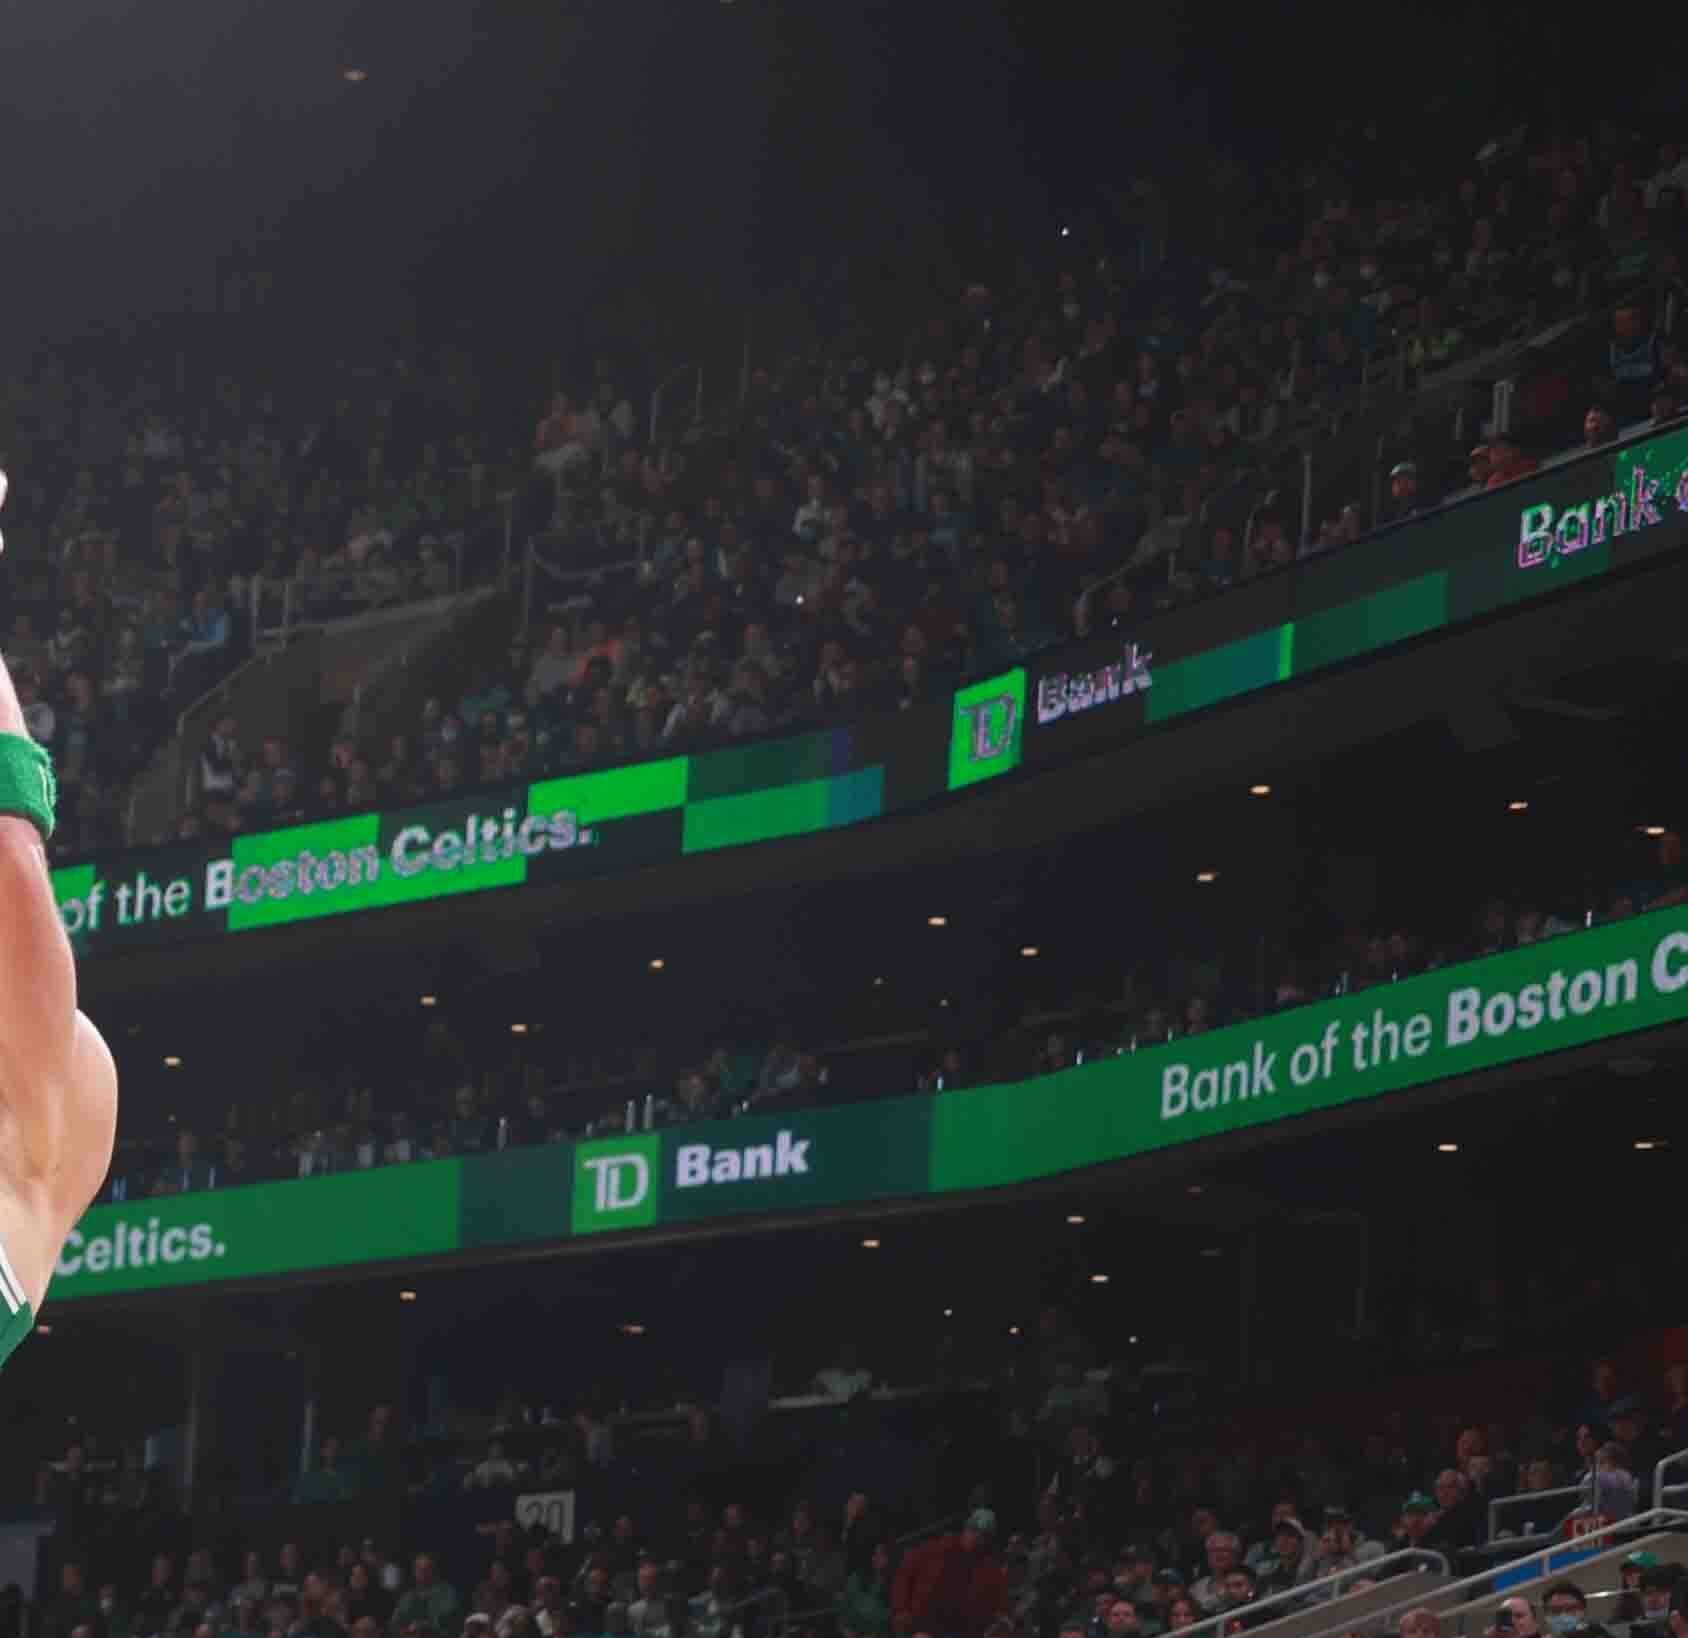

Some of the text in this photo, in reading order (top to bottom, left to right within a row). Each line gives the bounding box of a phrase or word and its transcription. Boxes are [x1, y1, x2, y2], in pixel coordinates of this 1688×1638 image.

[1038, 643, 1152, 724] Bank
[59, 808, 592, 934] of the Boston Celtics.
[1161, 1041, 1277, 1120] Bank
[1289, 1021, 1343, 1086] of
[1352, 1006, 1432, 1072] the
[1446, 958, 1640, 1048] Boston
[583, 1130, 810, 1212] TD Bank
[55, 1216, 227, 1277] Celtics.
